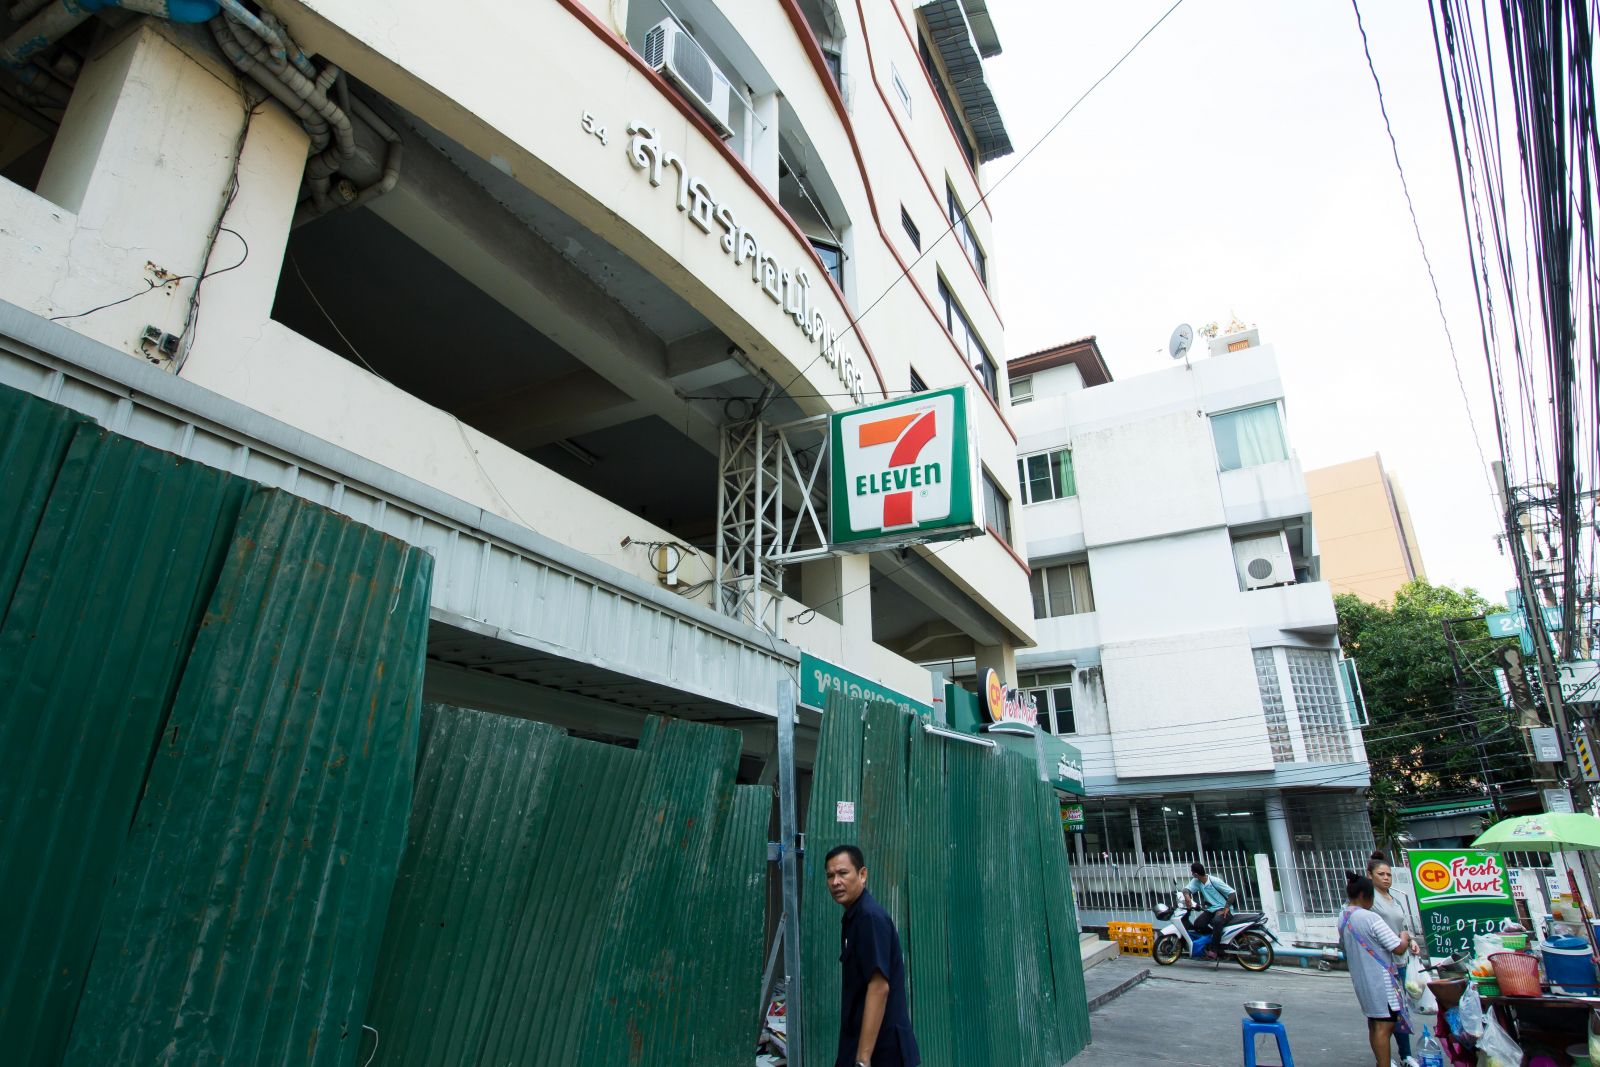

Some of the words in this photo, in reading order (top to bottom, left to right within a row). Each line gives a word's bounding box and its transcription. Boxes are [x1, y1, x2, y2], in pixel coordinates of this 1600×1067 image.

[580, 109, 608, 145] 54
[859, 410, 937, 527] 7
[1422, 869, 1446, 882] CP
[1452, 858, 1500, 877] Fresh
[1456, 877, 1501, 893] Mart
[1431, 912, 1450, 924] เปิด
[1432, 924, 1451, 932] Open
[1434, 933, 1452, 946] ปิด
[1460, 938, 1470, 949] 2
